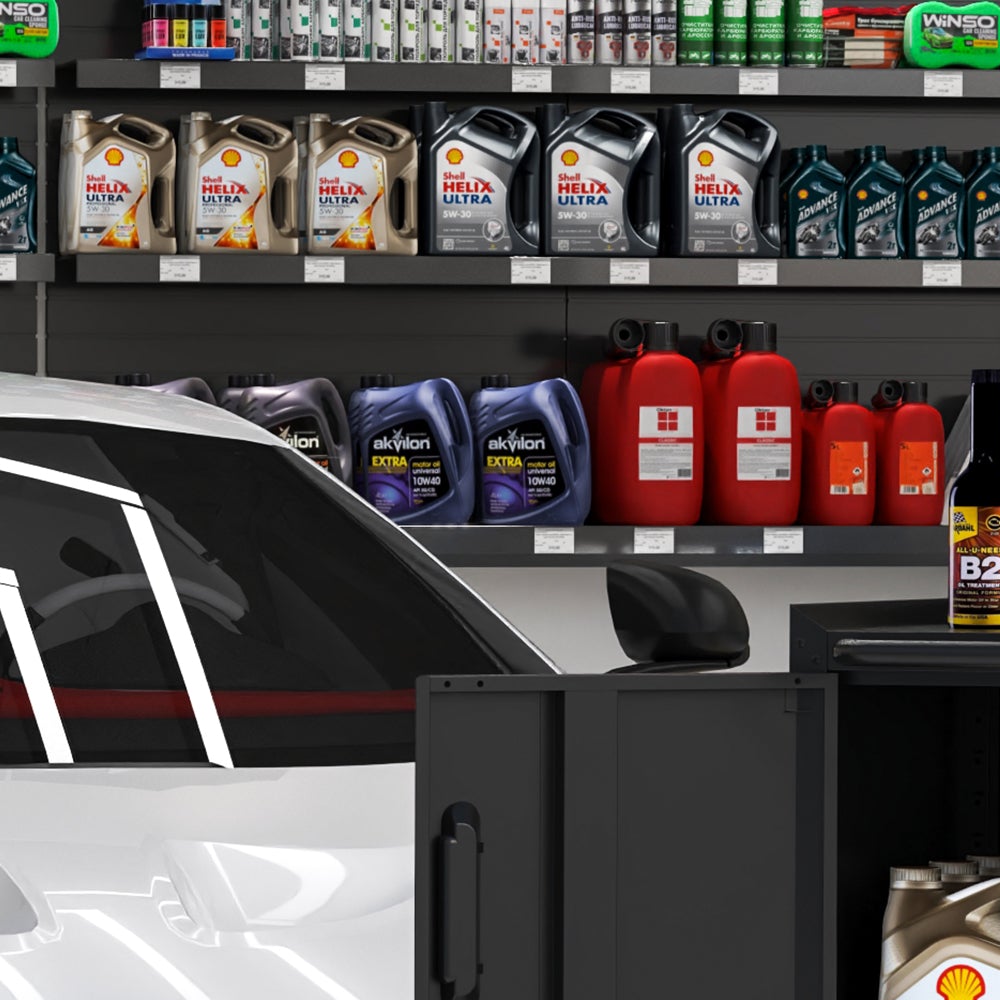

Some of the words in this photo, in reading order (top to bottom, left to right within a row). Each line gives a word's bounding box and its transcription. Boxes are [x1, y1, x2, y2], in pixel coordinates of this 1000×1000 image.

[86, 174, 106, 182] Shell
[319, 177, 340, 185] Shell
[443, 172, 466, 180] Shell
[558, 173, 581, 181] Shell
[695, 174, 716, 182] Shell
[86, 182, 132, 194] HELIX
[202, 183, 249, 195] HELIX
[319, 184, 367, 196] HELIX
[443, 180, 496, 193] HELIX
[558, 182, 611, 194] HELIX
[695, 182, 742, 196] HELIX
[86, 194, 125, 202] ULTRA
[202, 195, 242, 203] ULTRA
[319, 196, 359, 204] ULTRA
[443, 194, 492, 205] ULTRA
[558, 195, 608, 206] ULTRA
[695, 196, 740, 206] ULTRA
[797, 191, 839, 223] ADVANCE
[856, 191, 897, 223] ADVANCE
[917, 192, 957, 224] ADVANCE
[443, 210, 472, 218] 5W-30
[557, 211, 588, 220] 5W-30
[694, 212, 721, 220] 5W-30
[373, 435, 431, 454] akvilon
[488, 436, 546, 454] akvilon
[371, 455, 408, 467] EXTRA
[487, 456, 523, 468] EXTRA
